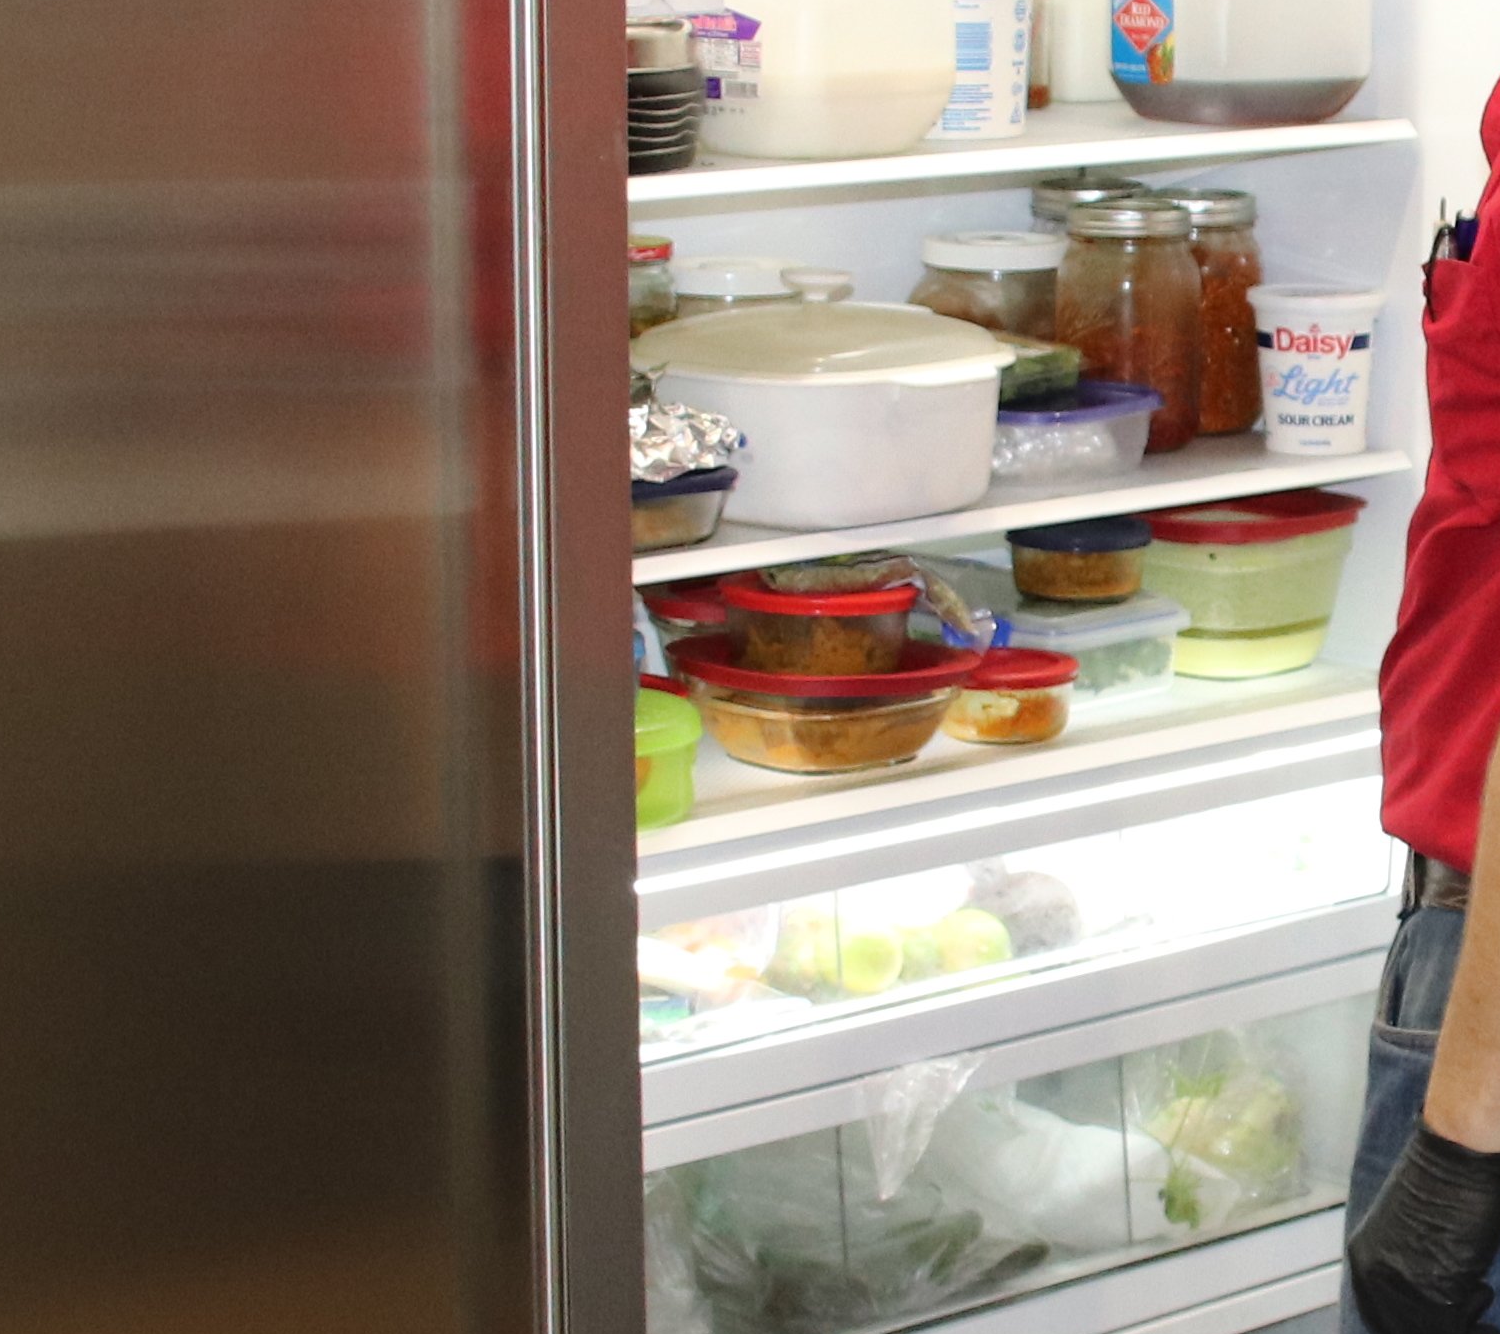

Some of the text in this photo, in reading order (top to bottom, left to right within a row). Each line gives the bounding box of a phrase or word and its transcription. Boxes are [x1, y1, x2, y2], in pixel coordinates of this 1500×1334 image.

[1276, 327, 1352, 360] Daisy
[1273, 365, 1359, 405] Light
[1278, 414, 1355, 426] SOUR CREAM
